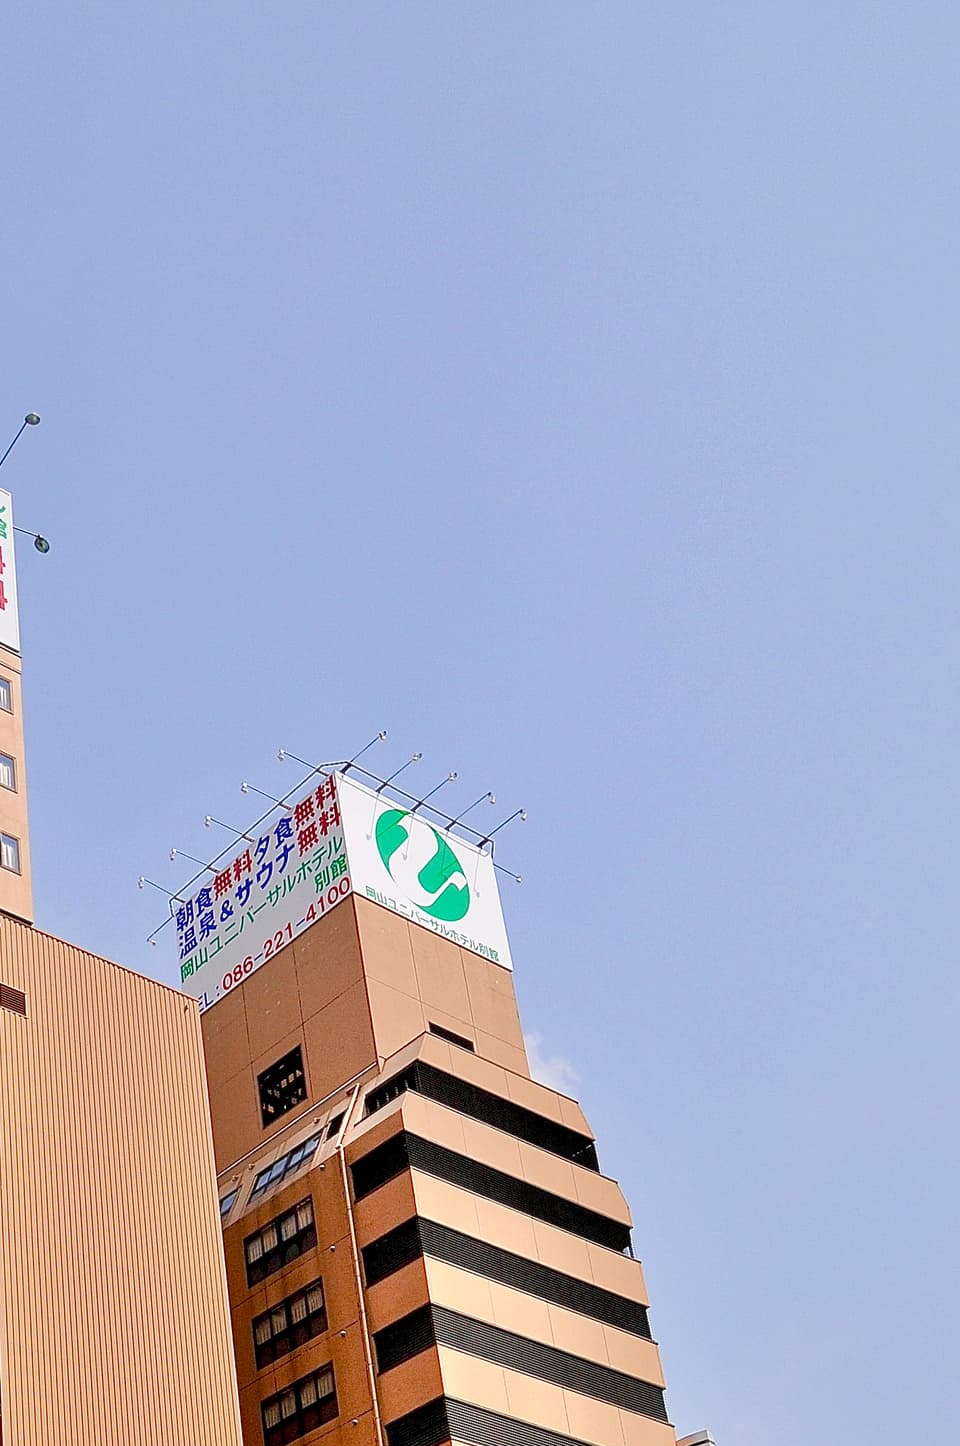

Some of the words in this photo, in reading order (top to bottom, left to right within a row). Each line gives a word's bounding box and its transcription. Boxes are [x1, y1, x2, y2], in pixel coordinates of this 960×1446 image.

[180, 835, 344, 984] 岡山ユニバーサルホテル
[314, 853, 348, 893] 別館
